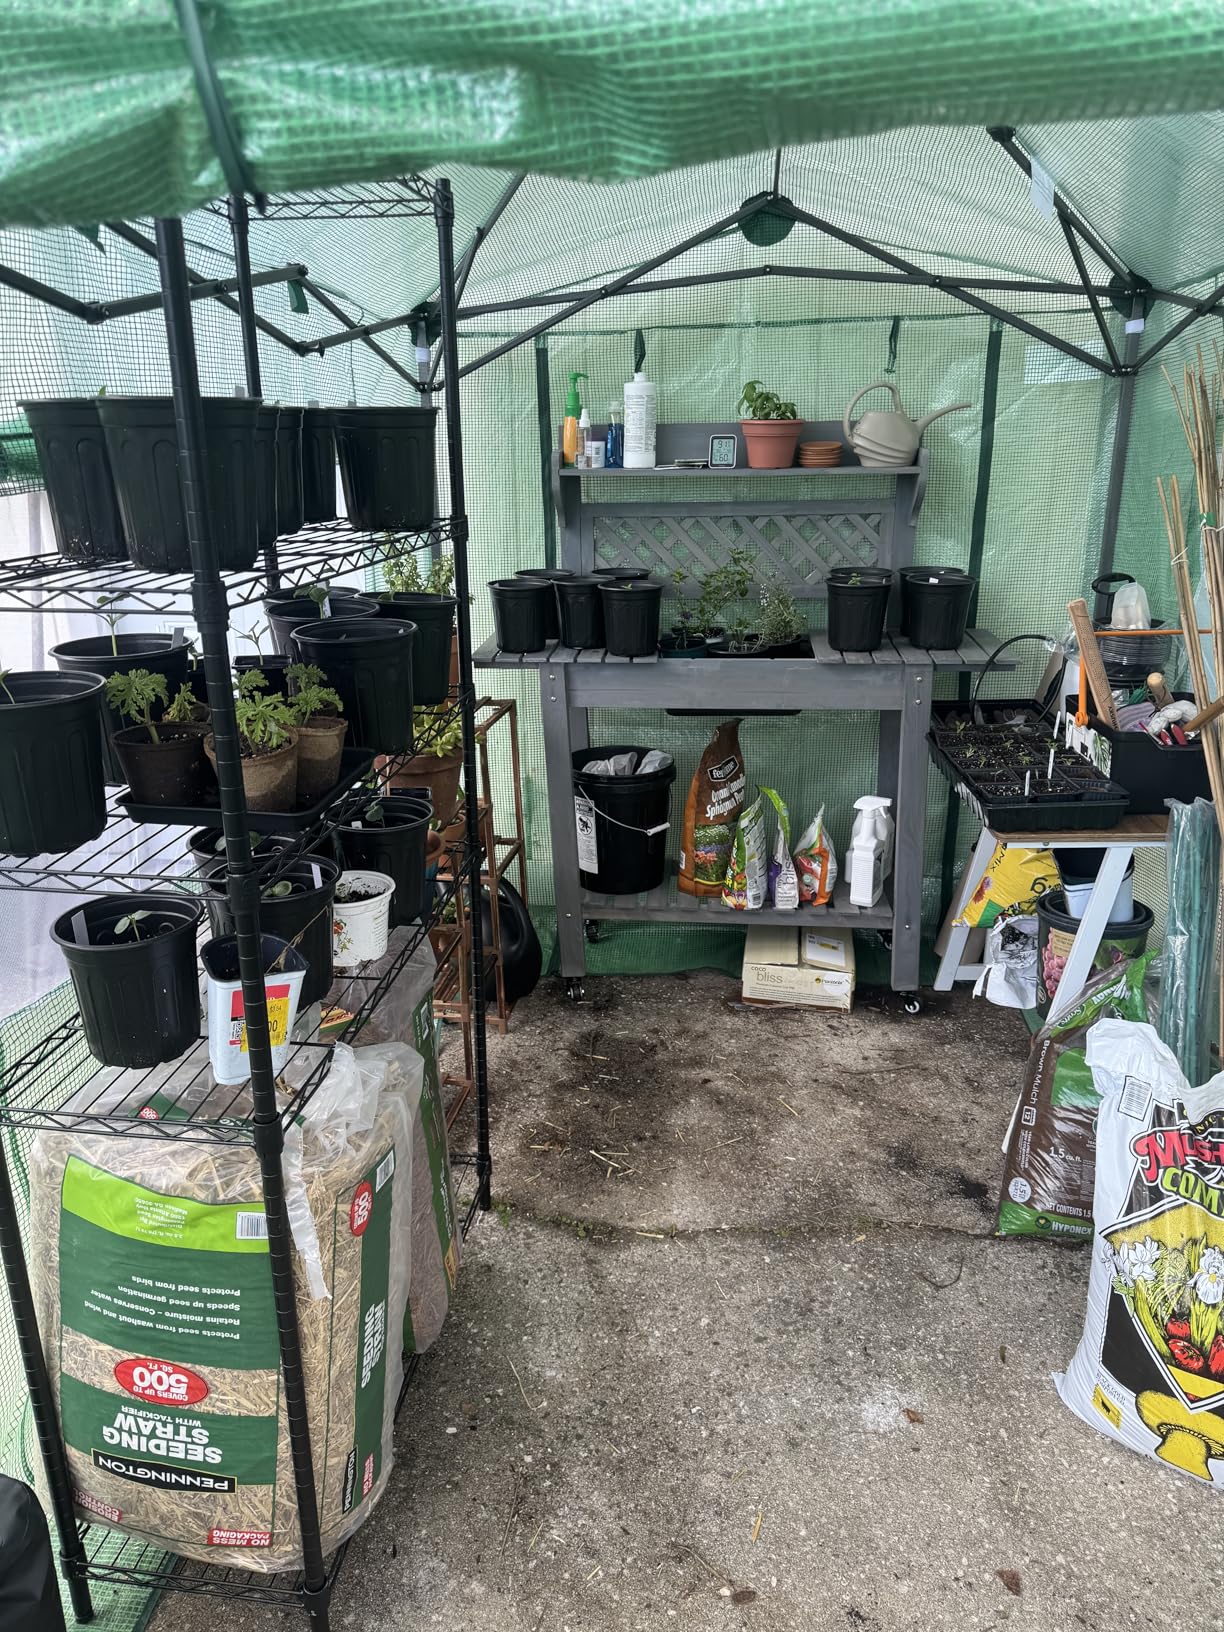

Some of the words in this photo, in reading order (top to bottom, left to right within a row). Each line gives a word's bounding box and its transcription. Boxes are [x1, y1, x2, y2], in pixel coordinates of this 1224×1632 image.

[756, 971, 784, 983] bliss
[1038, 1040, 1050, 1072] Brown
[1030, 1074, 1042, 1104] Mulch
[1049, 1146, 1065, 1159] 1.5
[357, 1192, 369, 1225] 500
[1056, 1203, 1082, 1217] CONTENTS
[131, 1275, 153, 1286] birds
[155, 1280, 176, 1291] from
[117, 1285, 167, 1304] germination
[177, 1284, 199, 1293] seed
[201, 1287, 241, 1296] Protects
[90, 1289, 112, 1303] water
[84, 1300, 102, 1313] wind
[113, 1297, 156, 1316] Conserves
[169, 1298, 190, 1307] seed
[192, 1300, 204, 1309] up
[206, 1302, 241, 1311] Speeds
[102, 1308, 117, 1320] and
[164, 1311, 203, 1322] moisture
[118, 1314, 153, 1329] washout
[205, 1316, 240, 1326] Retains
[155, 1323, 176, 1333] from
[178, 1327, 199, 1335] seed
[202, 1330, 240, 1340] Protects
[372, 1305, 383, 1367] STRAW
[360, 1304, 376, 1389] SEEDING
[146, 1362, 158, 1370] FT.
[160, 1364, 173, 1373] SQ.
[132, 1365, 188, 1394] 500
[132, 1385, 143, 1394] TO
[143, 1388, 155, 1396] UP
[156, 1390, 188, 1402] COVERS
[120, 1405, 173, 1422] TACKIFIER
[112, 1411, 209, 1444] STRAW
[175, 1417, 202, 1427] WITH
[102, 1425, 223, 1464] SEEDING
[98, 1455, 229, 1491] PENNINGTON
[343, 1451, 356, 1510] PENNINGTON
[72, 1487, 120, 1515] CONTROL
[74, 1496, 119, 1522] EROSION
[212, 1529, 270, 1540] PACKAGING
[212, 1537, 248, 1546] MESS
